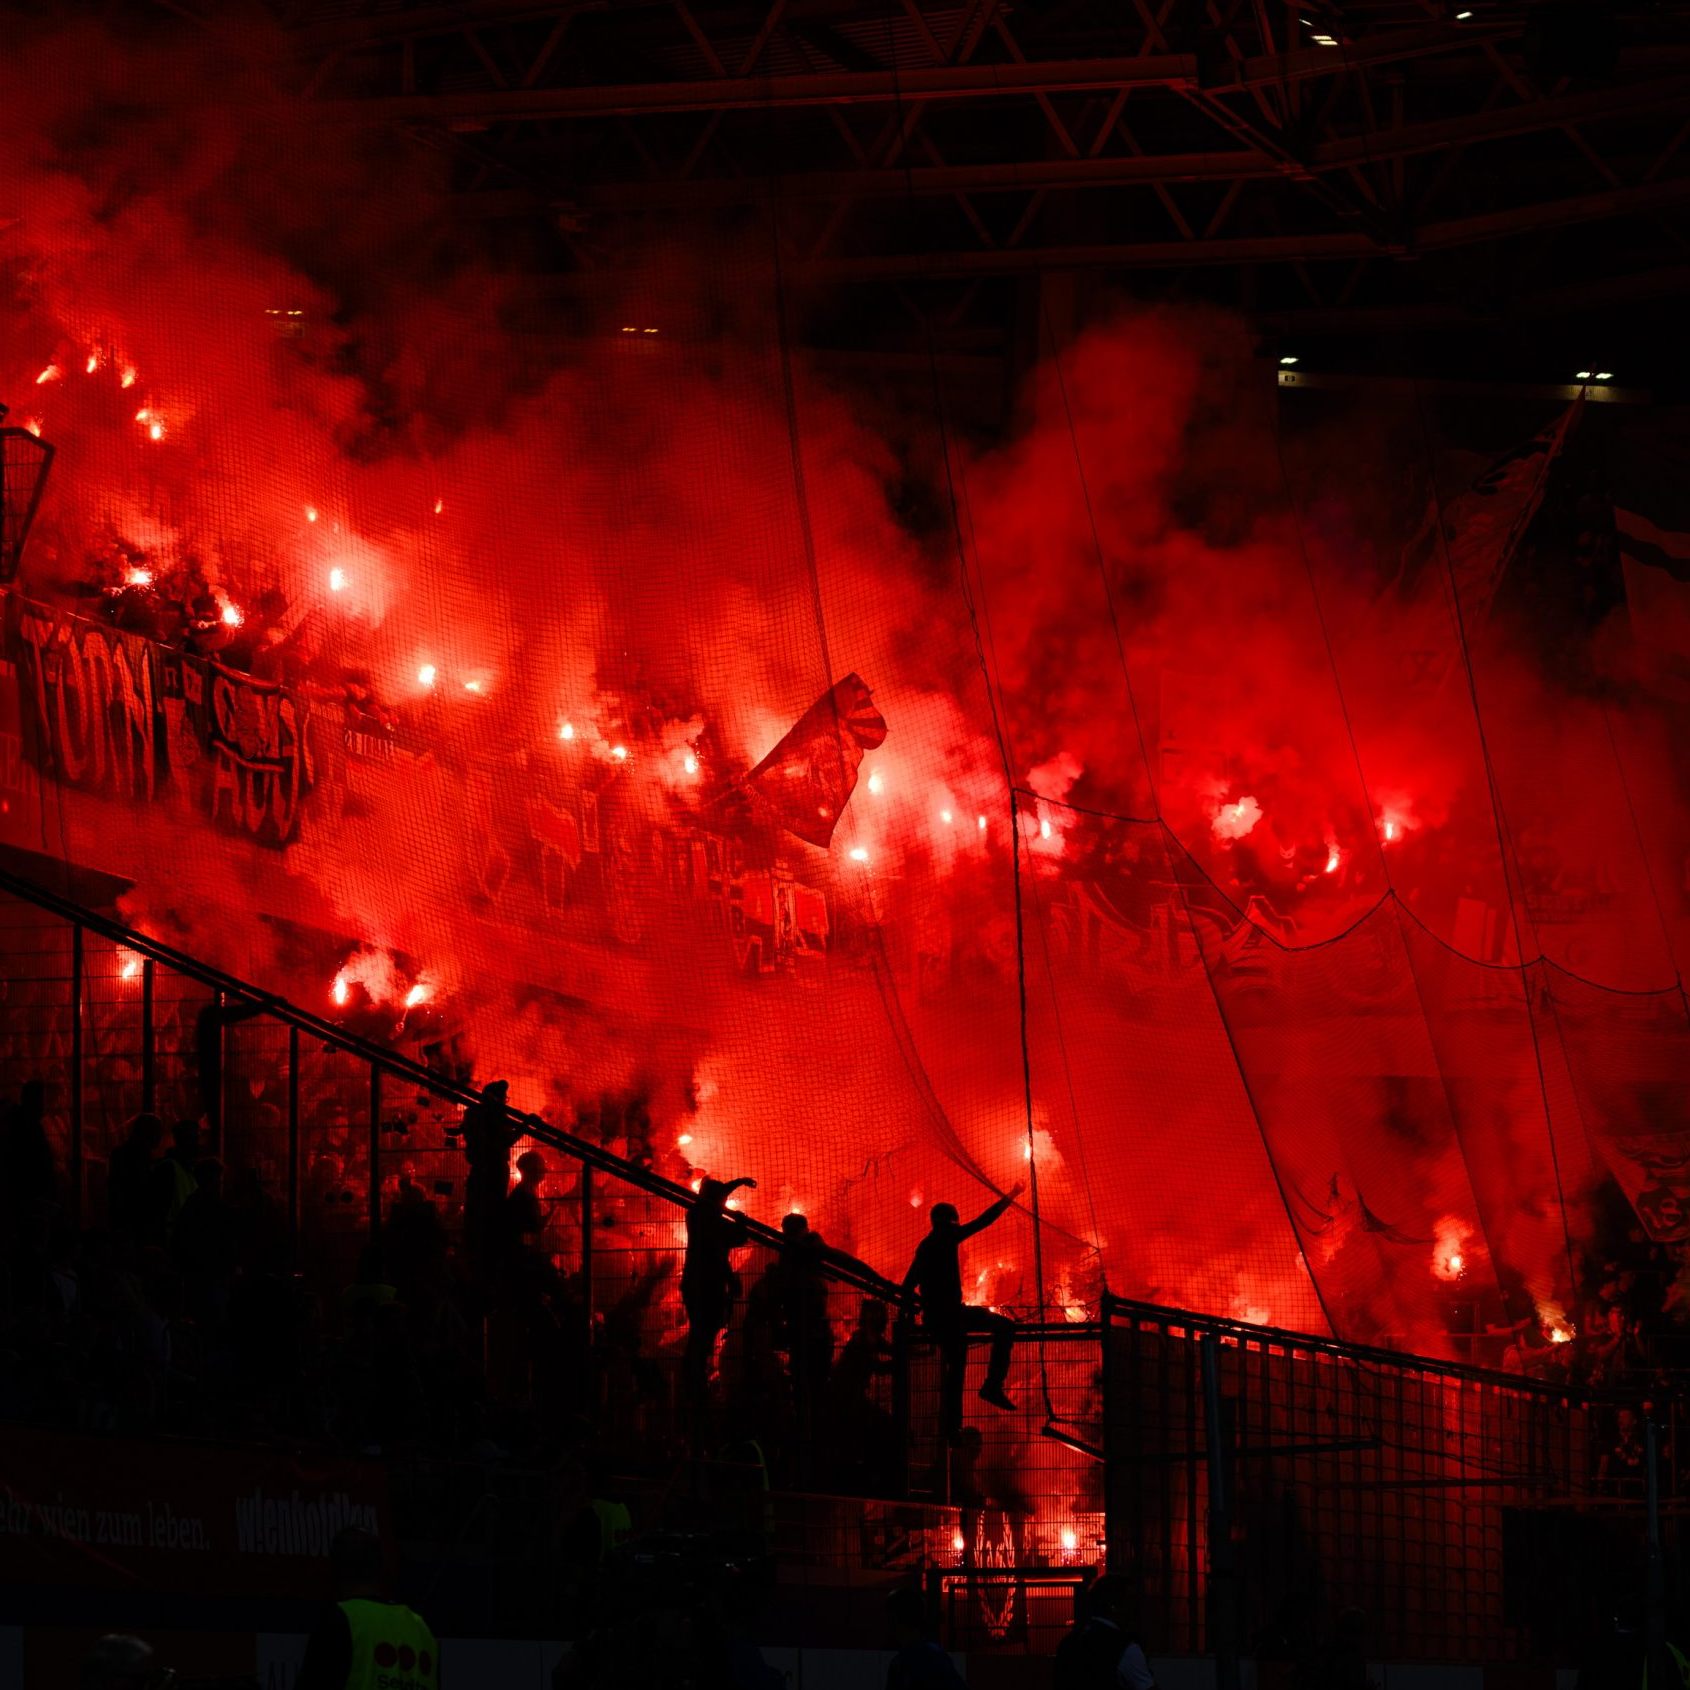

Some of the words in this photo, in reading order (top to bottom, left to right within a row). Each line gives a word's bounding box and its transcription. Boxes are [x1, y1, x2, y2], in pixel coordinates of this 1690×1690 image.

[33, 1490, 91, 1542] wien
[95, 1511, 144, 1546] zum
[145, 1499, 212, 1553] leben.
